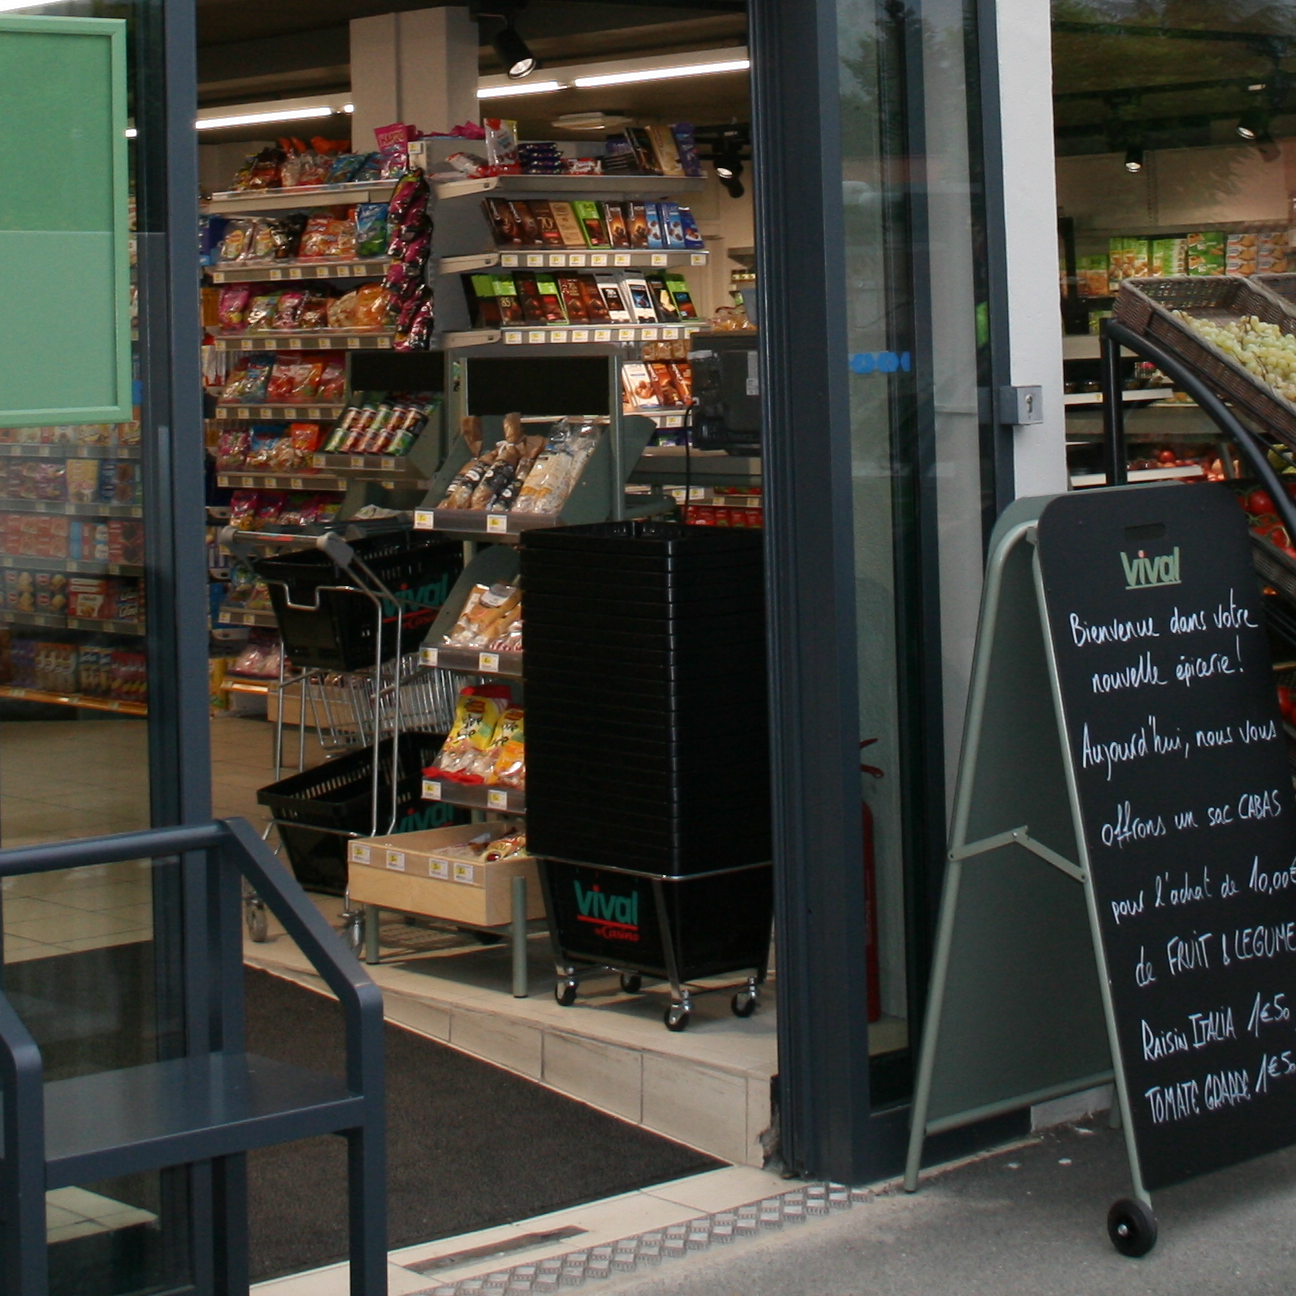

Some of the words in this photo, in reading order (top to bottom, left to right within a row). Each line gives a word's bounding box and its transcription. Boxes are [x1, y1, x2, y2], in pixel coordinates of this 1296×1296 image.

[1070, 612, 1159, 647] Bienvenue
[1170, 607, 1207, 634] dans
[1214, 588, 1258, 628] votre
[1092, 651, 1168, 693] nouvelle
[1196, 727, 1233, 747] nous
[1239, 720, 1277, 744] vous
[1101, 800, 1167, 849] offrons
[1175, 811, 1198, 830] un
[1207, 804, 1233, 826] sac
[1238, 789, 1282, 820] CABAS
[574, 880, 638, 925] Vival
[1111, 890, 1144, 925] pour
[1220, 874, 1239, 898] de
[1135, 945, 1156, 987] de
[1144, 1079, 1200, 1124] TOMATE
